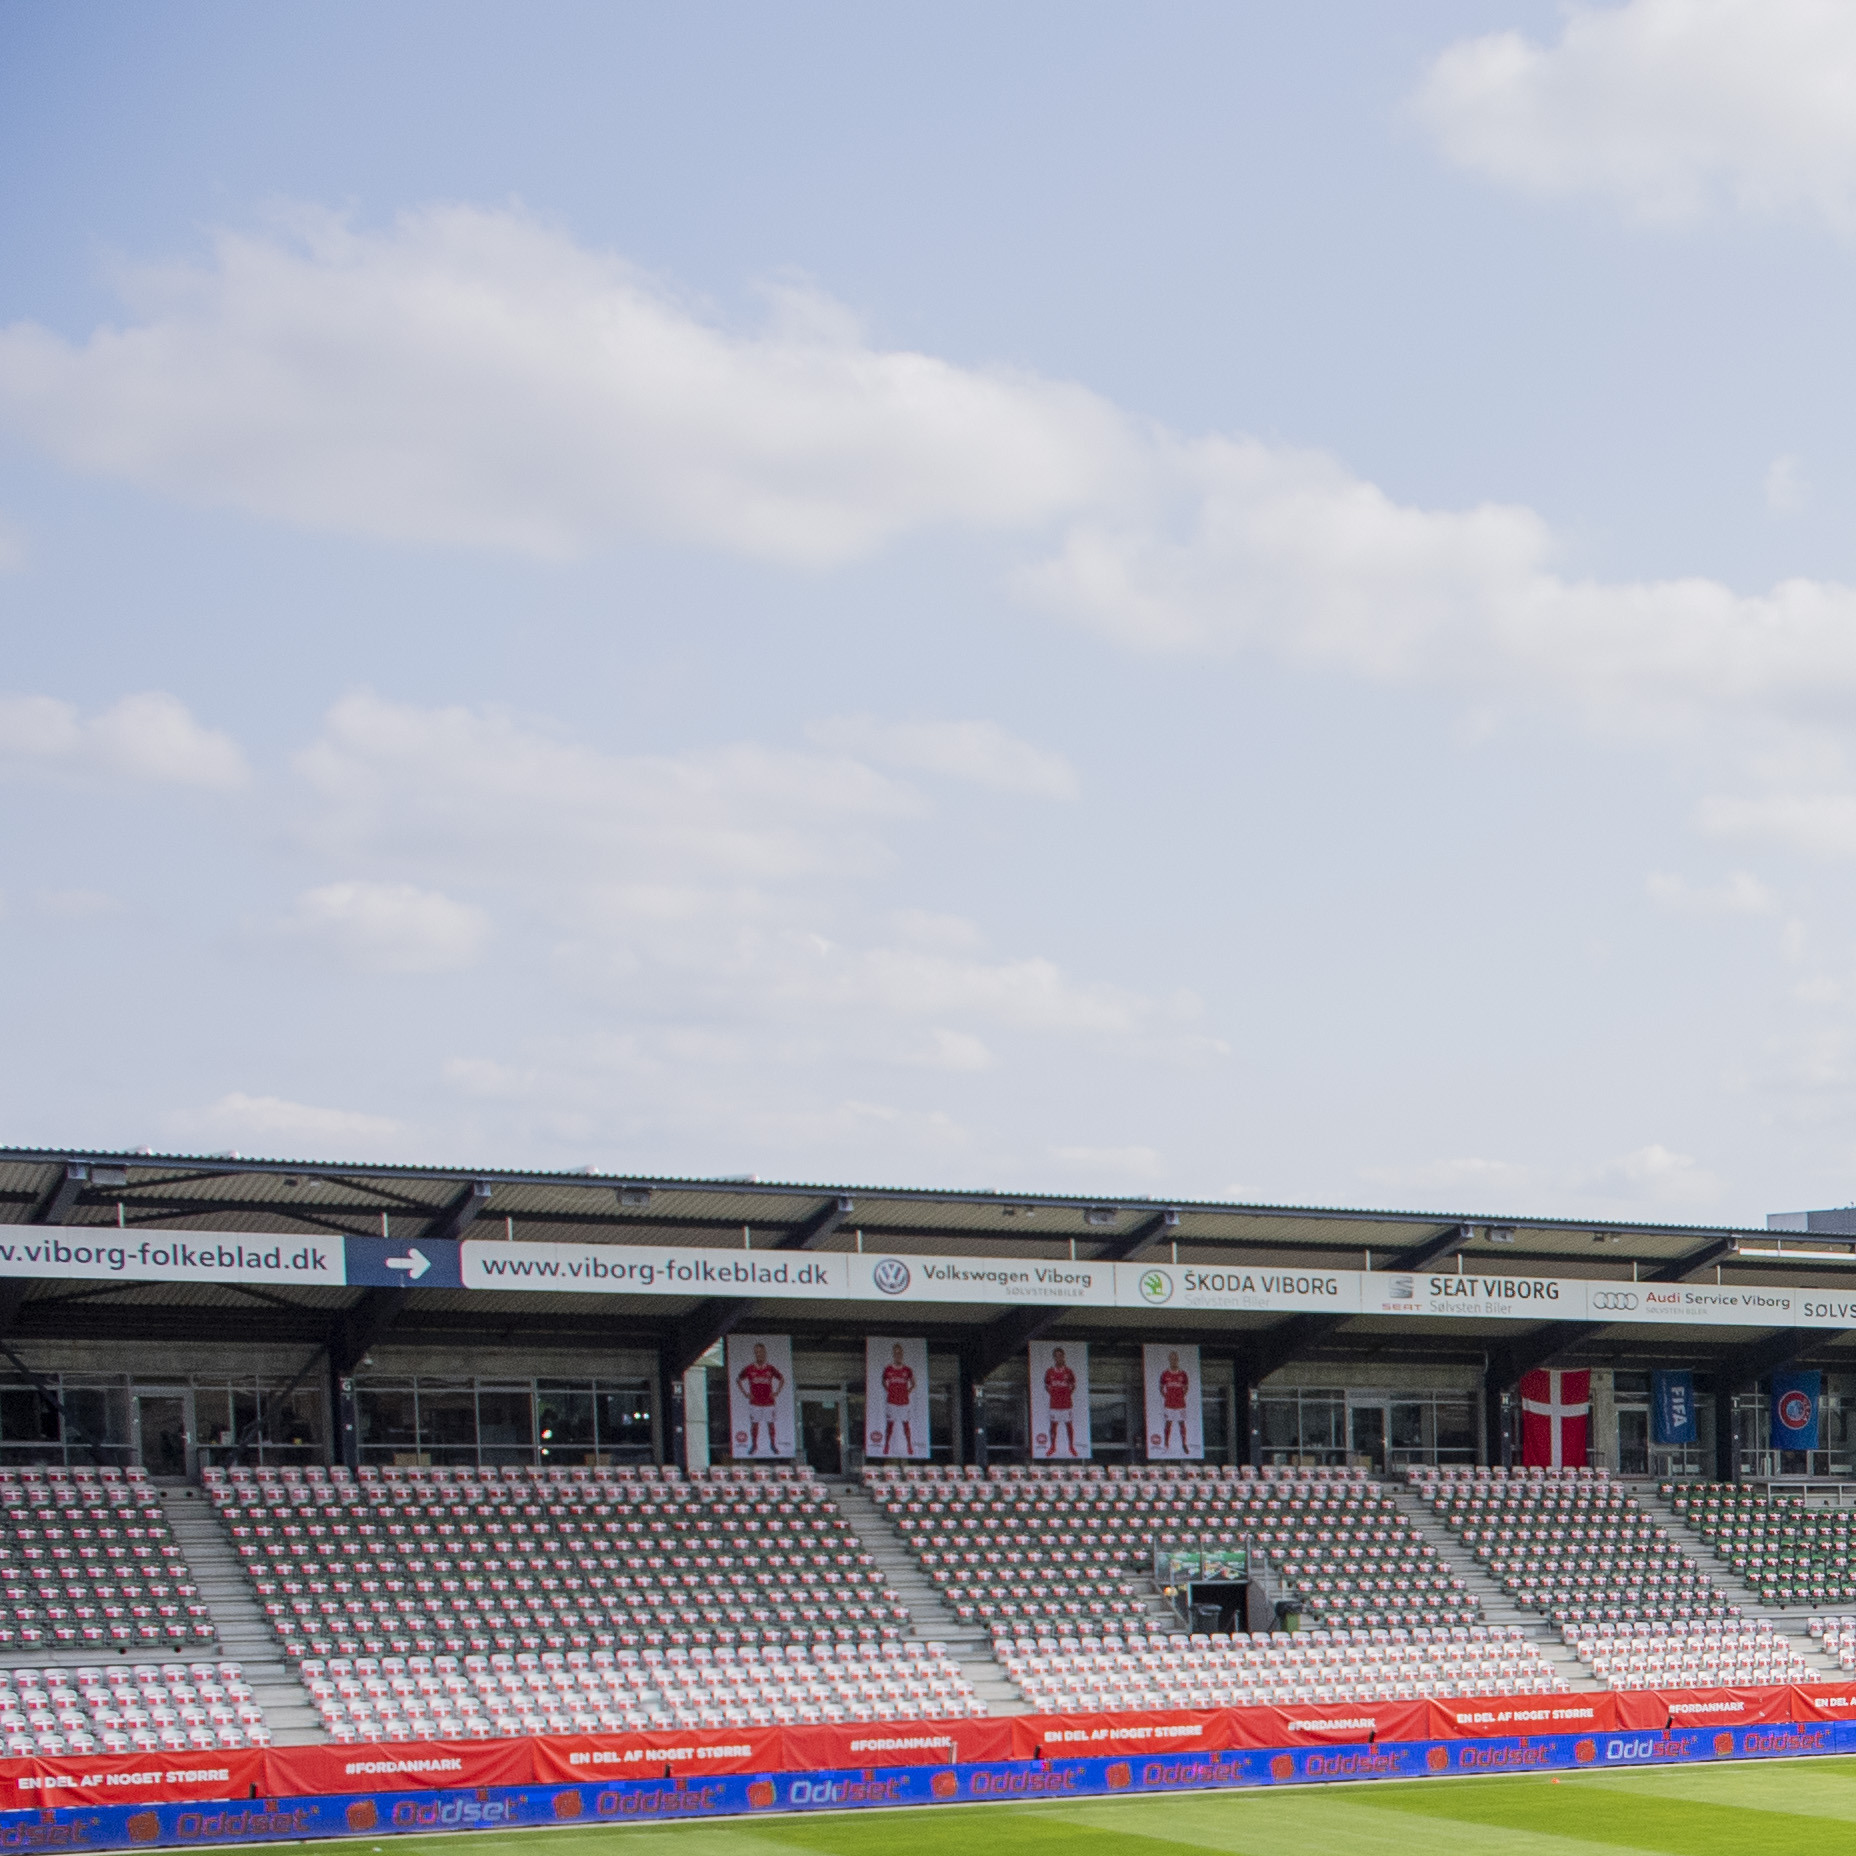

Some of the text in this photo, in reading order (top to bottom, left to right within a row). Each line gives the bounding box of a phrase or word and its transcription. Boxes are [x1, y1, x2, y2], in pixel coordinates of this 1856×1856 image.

[482, 1256, 829, 1285] www.viborg-folkeblad.dk
[923, 1264, 1092, 1288] Volkswagen Viborg
[1184, 1270, 1338, 1296] ŠKODA VIBORG
[1430, 1277, 1559, 1300] SEAT VIBORG
[1382, 1303, 1423, 1311] SEAT
[1430, 1300, 1512, 1315] Sølvsten Biler
[1646, 1292, 1791, 1310] Audi Service Viborg
[1671, 1386, 1687, 1427] FIFA
[1669, 1701, 1744, 1713] #FORDANMARK
[1044, 1725, 1202, 1742] EN DEL AF NOGET STØRRE
[1288, 1718, 1376, 1731] #FORDANMARK
[851, 1736, 951, 1751] #FORDANMARK
[1607, 1738, 1690, 1759] Oddset
[1744, 1731, 1823, 1752] Oddset
[570, 1746, 751, 1764] EN DEL AF NOGET STØRRE
[1306, 1752, 1399, 1775] Oddset
[1460, 1742, 1548, 1766] Oddset
[346, 1758, 462, 1774] #FORDANMARK
[1144, 1761, 1240, 1784] Oddset
[18, 1770, 229, 1789] EN DEL AF NOGET STØRRE
[971, 1769, 1076, 1792] Oddset
[597, 1789, 716, 1814] Oddset
[790, 1779, 899, 1804] Oddset
[177, 1808, 311, 1837] Oddset
[394, 1798, 518, 1825] Oddset
